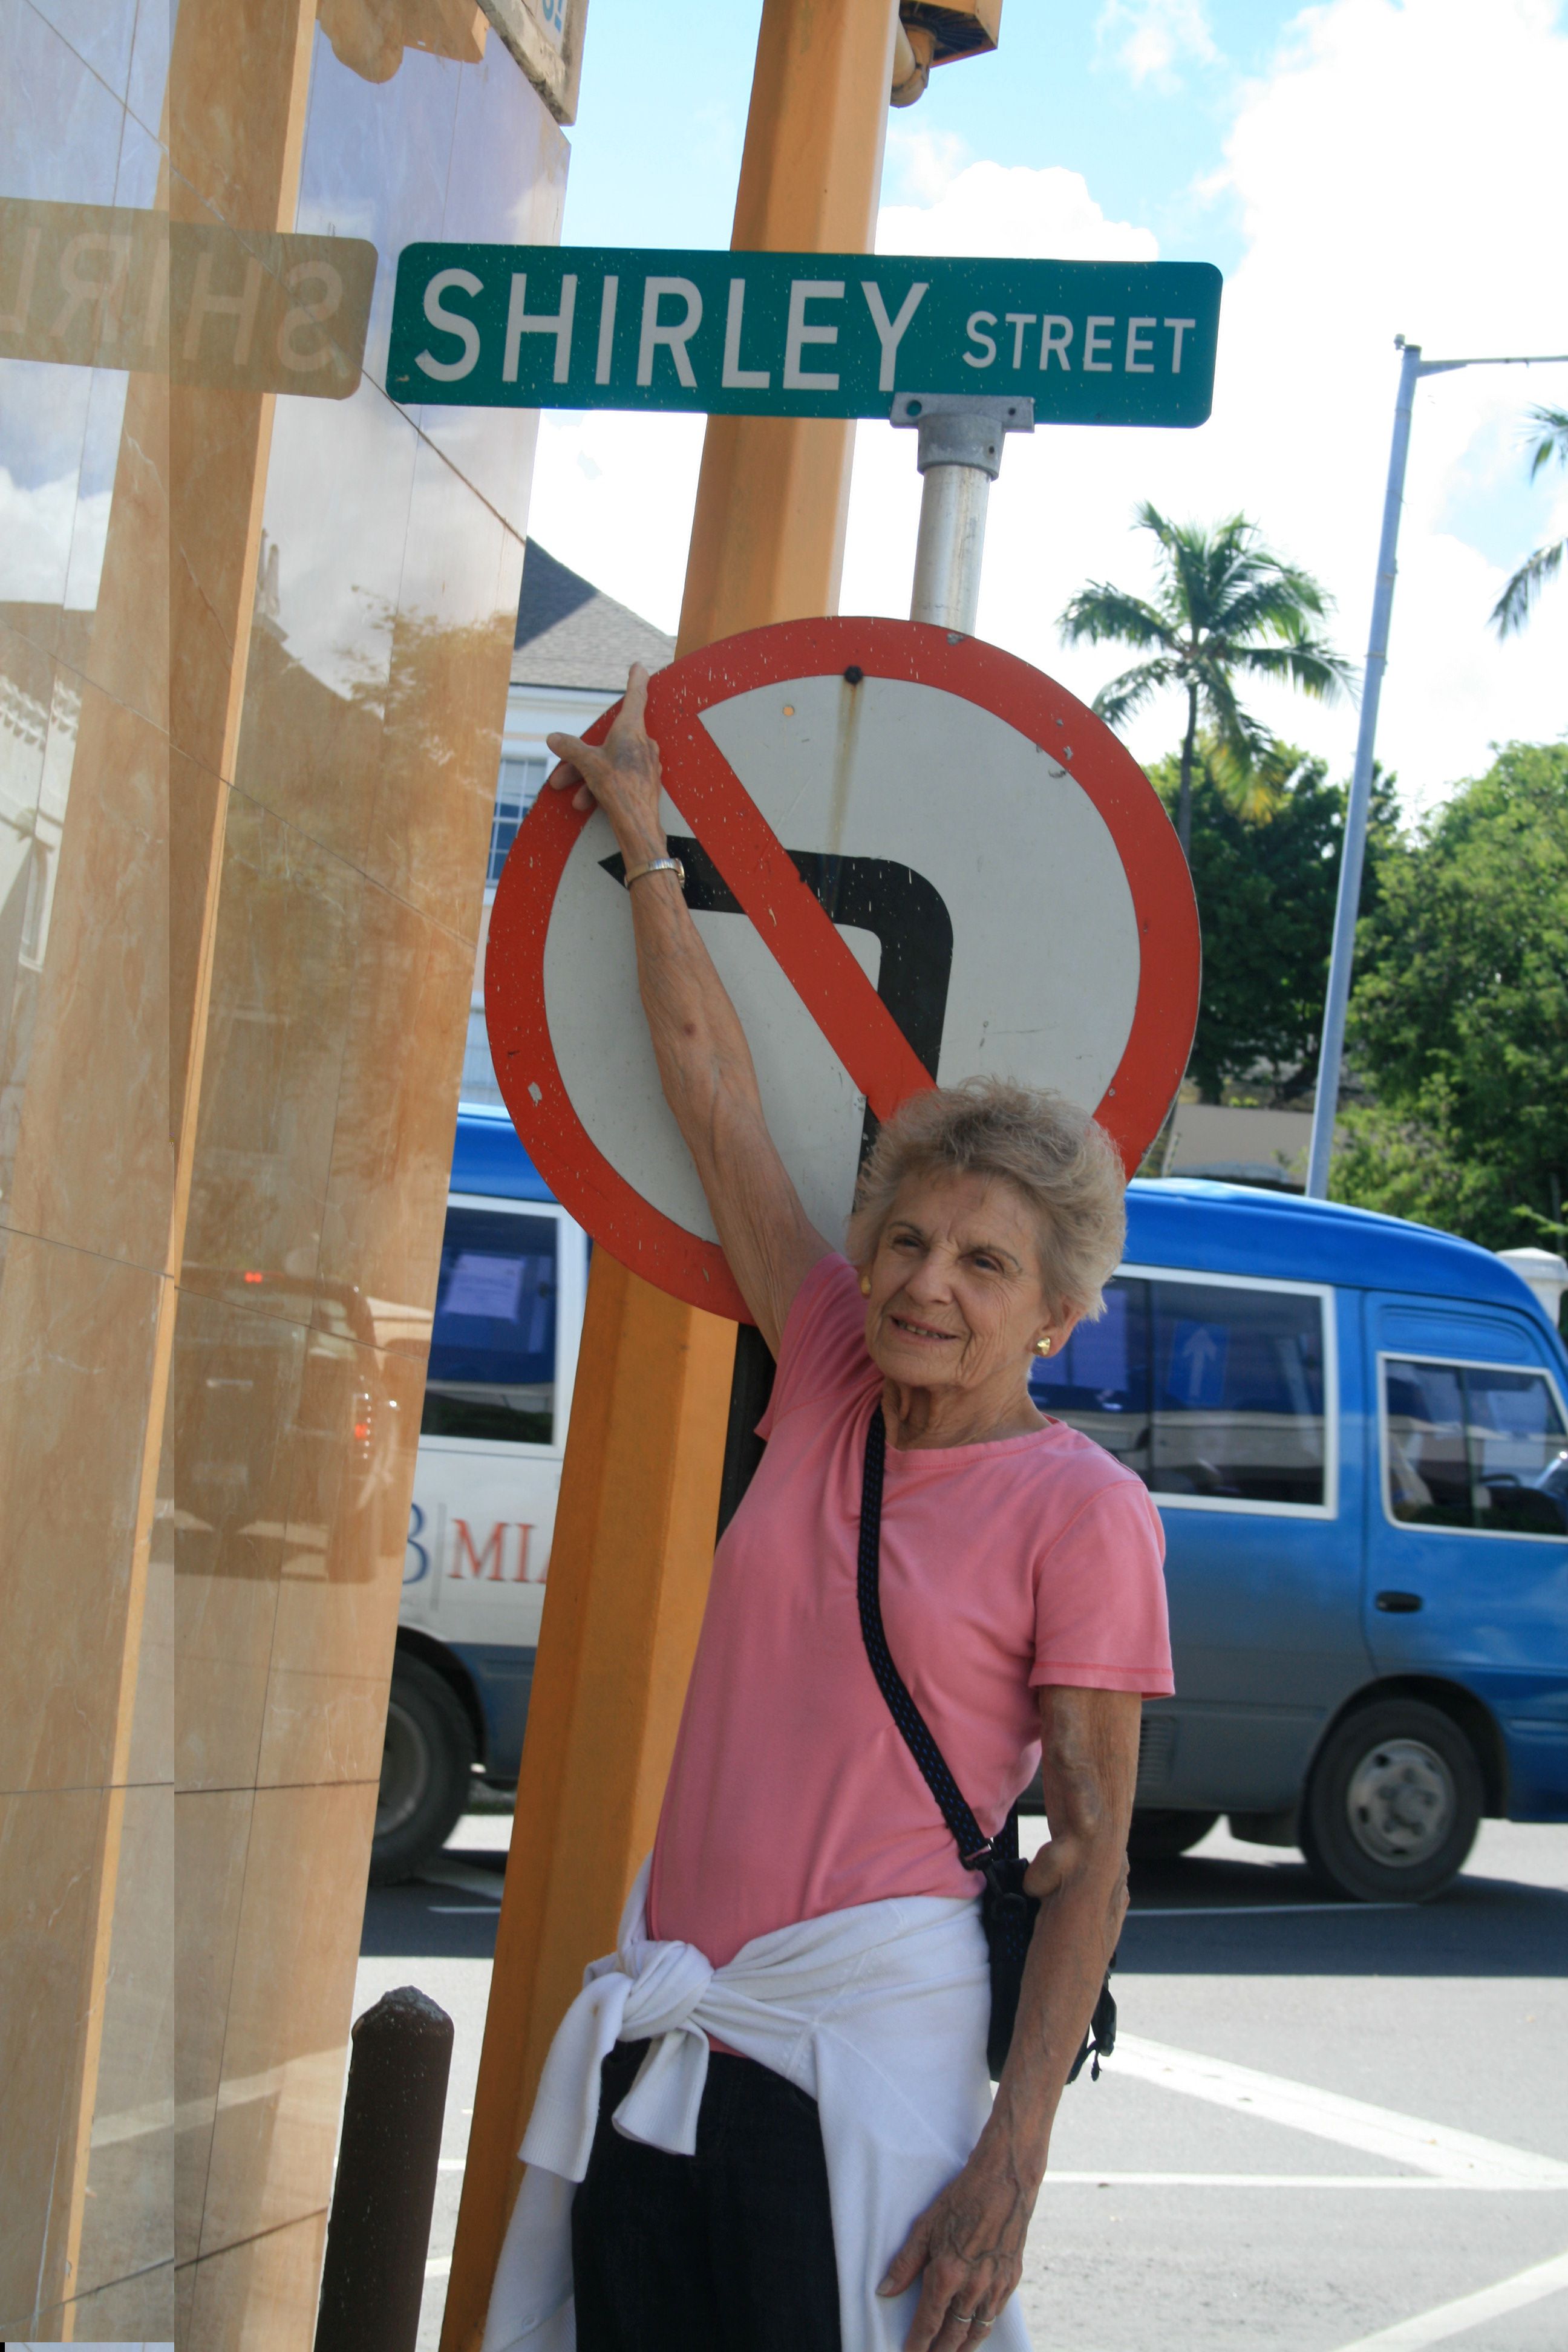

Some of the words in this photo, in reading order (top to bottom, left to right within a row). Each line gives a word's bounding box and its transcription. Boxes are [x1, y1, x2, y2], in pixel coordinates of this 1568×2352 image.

[414, 267, 930, 392] SHIRLEY
[962, 310, 1196, 374] STREET
[448, 1518, 550, 1584] MI
